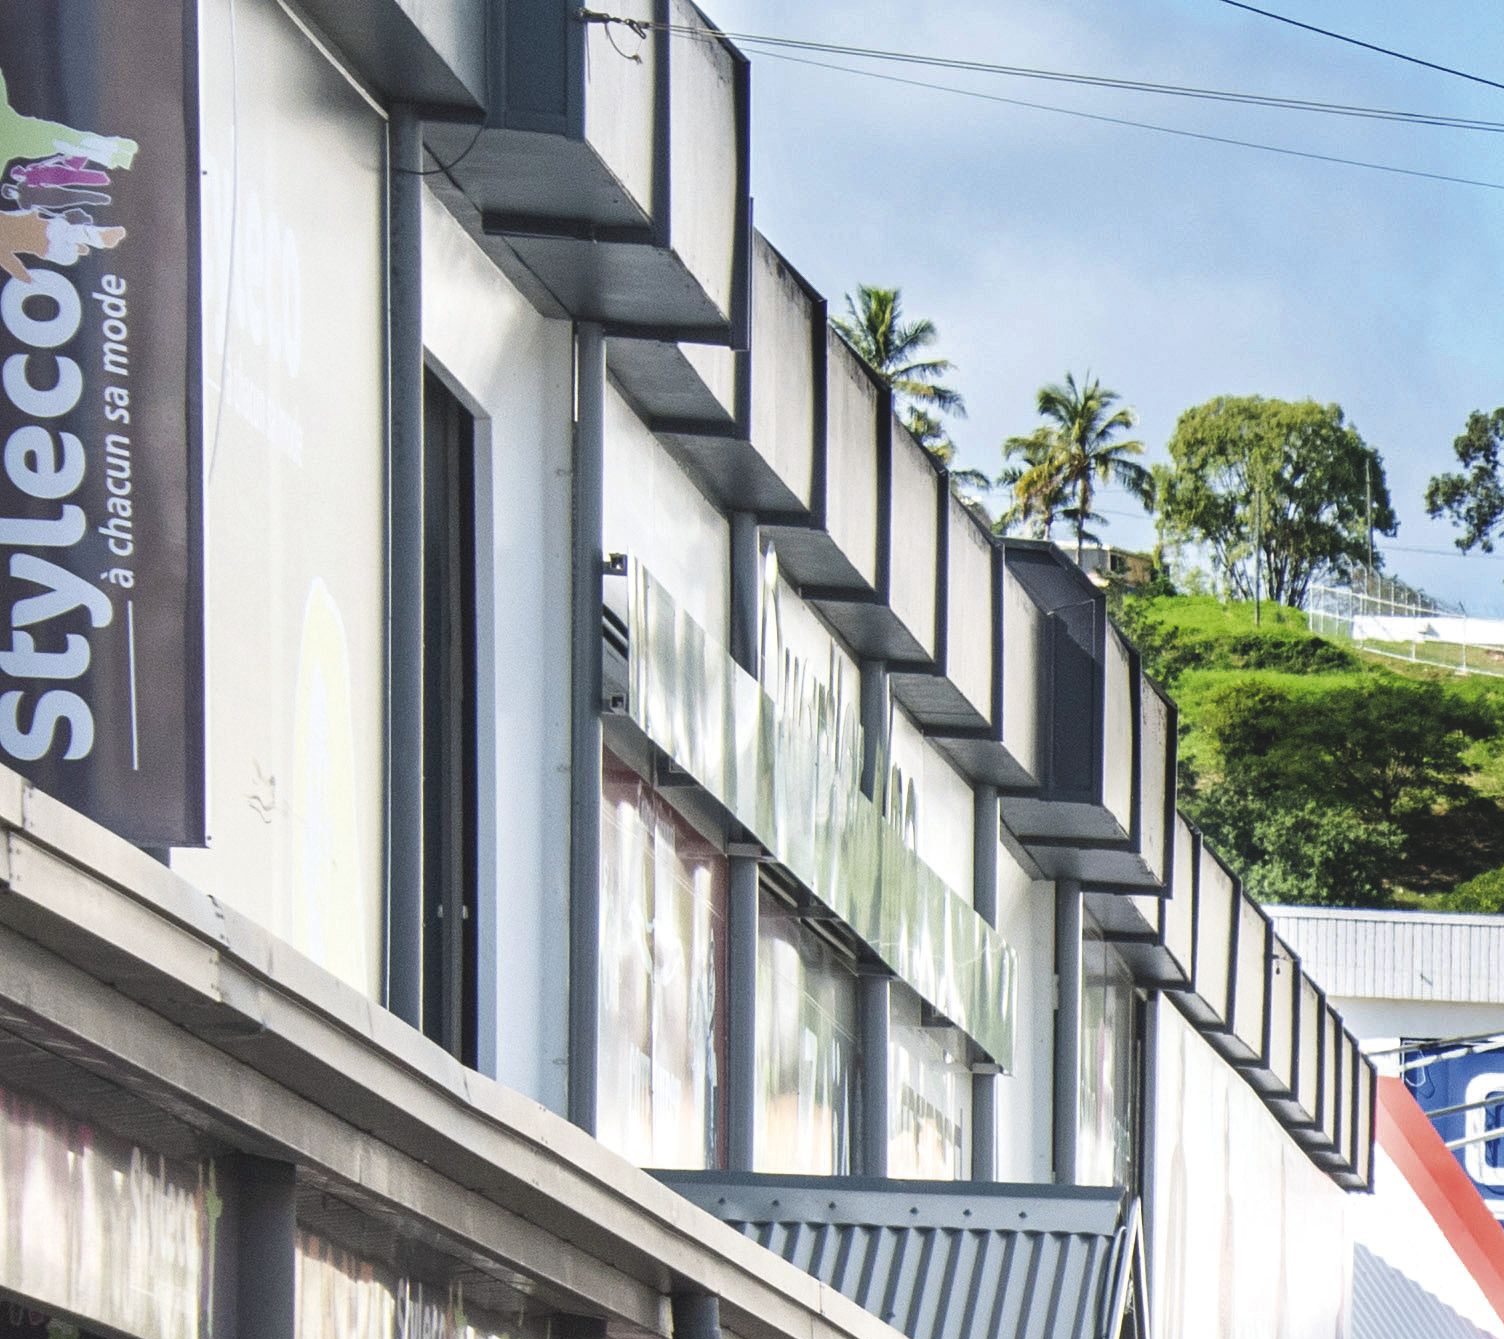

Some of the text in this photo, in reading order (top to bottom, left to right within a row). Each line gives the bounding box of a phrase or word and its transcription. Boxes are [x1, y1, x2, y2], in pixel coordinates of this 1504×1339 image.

[92, 272, 127, 374] mode
[100, 383, 130, 424] sa
[100, 435, 134, 568] chacun
